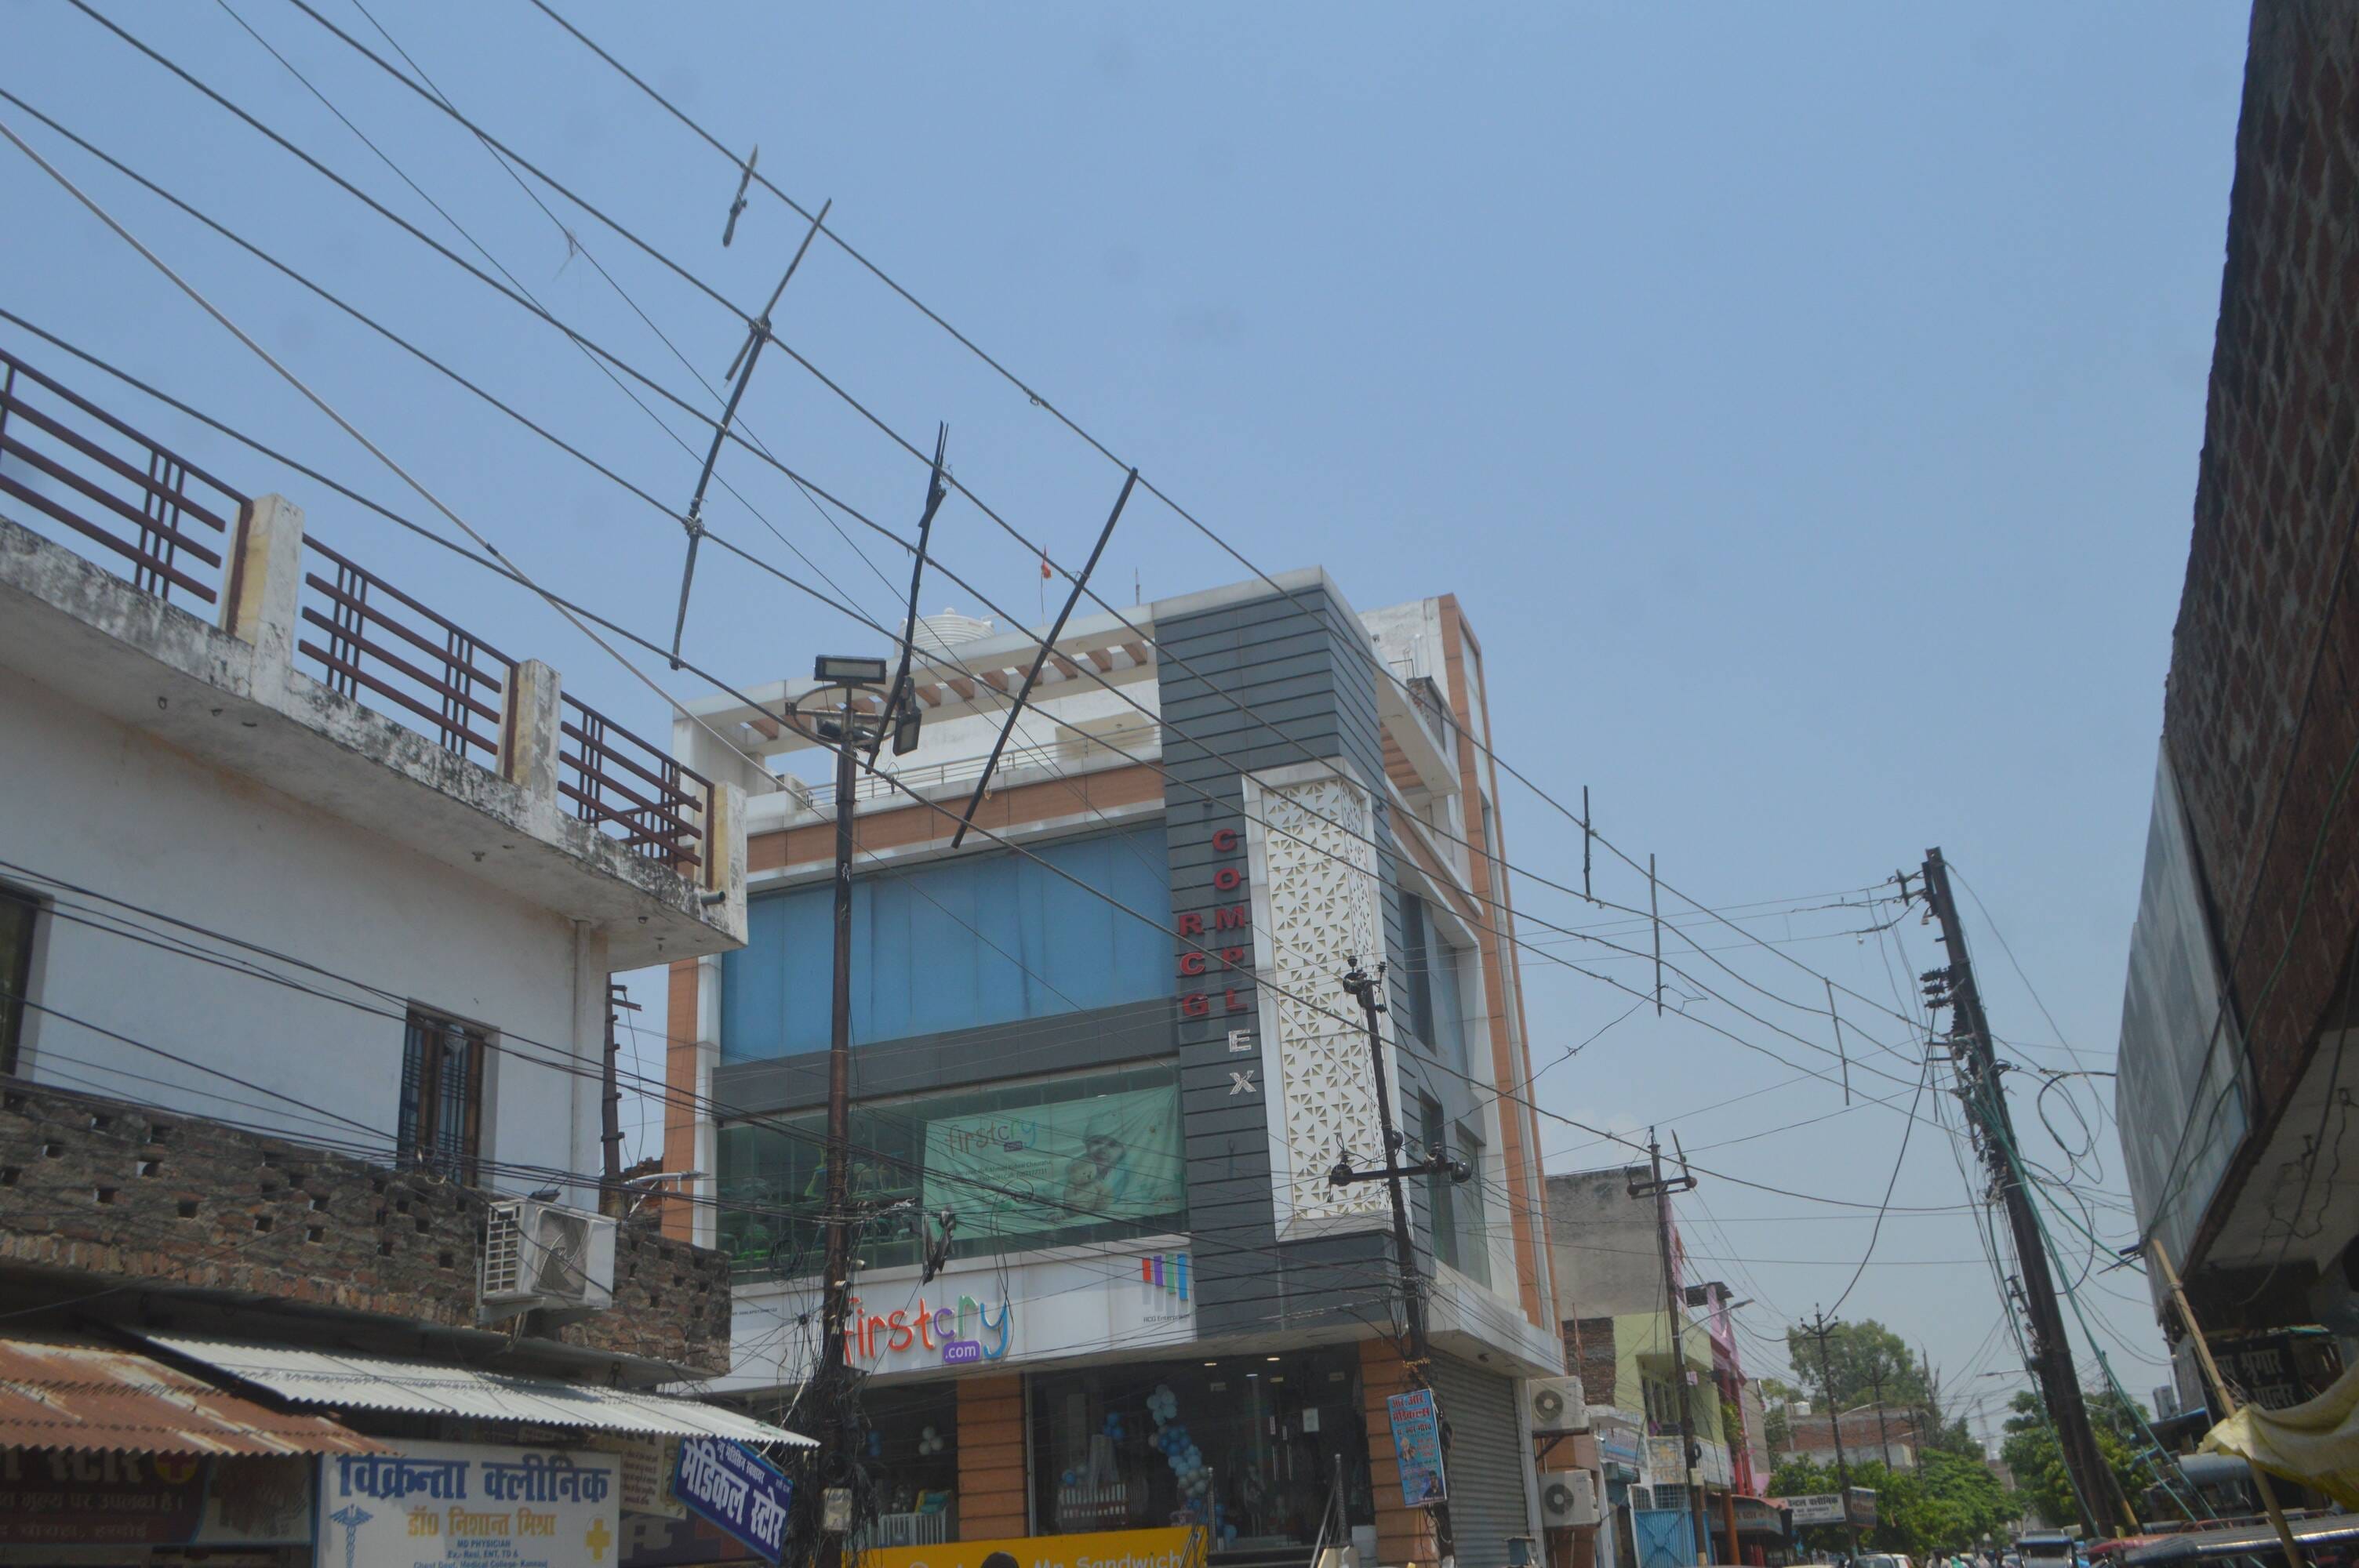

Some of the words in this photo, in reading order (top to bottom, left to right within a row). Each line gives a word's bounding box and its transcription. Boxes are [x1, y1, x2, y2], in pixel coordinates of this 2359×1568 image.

[1178, 912, 1210, 1017] RCG
[1212, 828, 1256, 1095] COMPLEX
[481, 1454, 612, 1503] क्लीनिक
[681, 1437, 750, 1526] मेडिकल
[751, 1485, 787, 1550] स्टोर
[471, 1539, 511, 1548] PHYSICIAN
